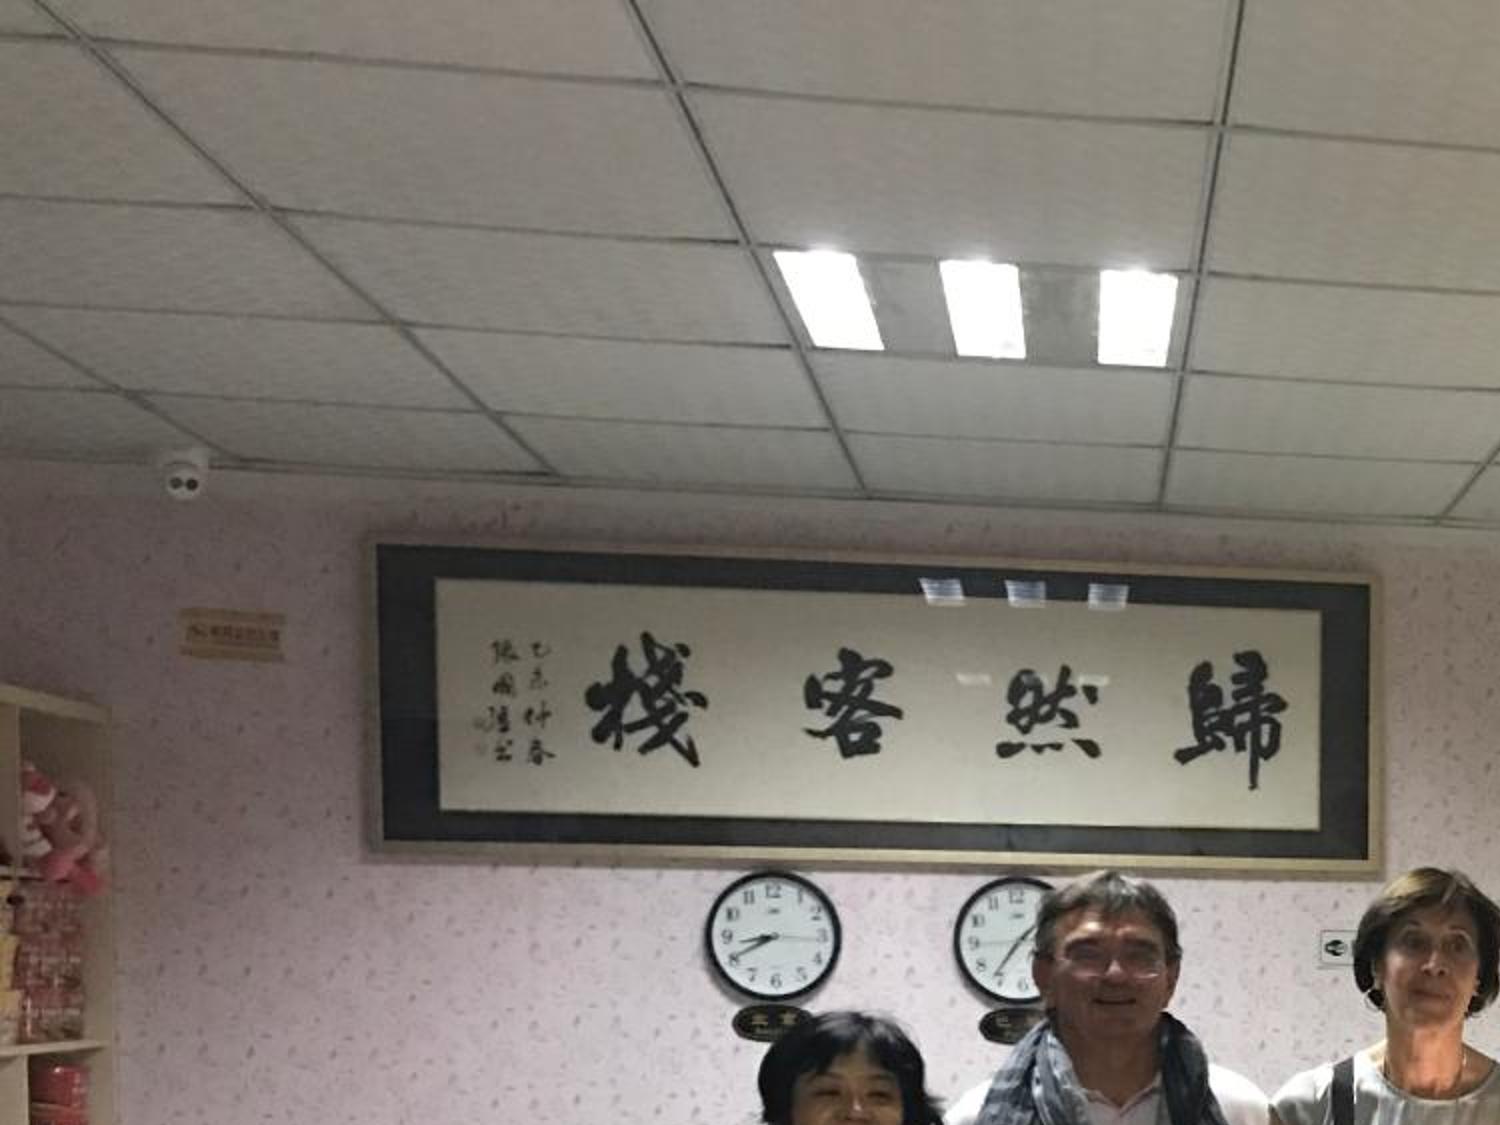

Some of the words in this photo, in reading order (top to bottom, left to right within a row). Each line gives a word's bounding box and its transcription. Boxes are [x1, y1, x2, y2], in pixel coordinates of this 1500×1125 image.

[766, 883, 781, 898] 12
[726, 907, 740, 922] 10
[721, 929, 733, 945] 9
[770, 973, 782, 989] 6
